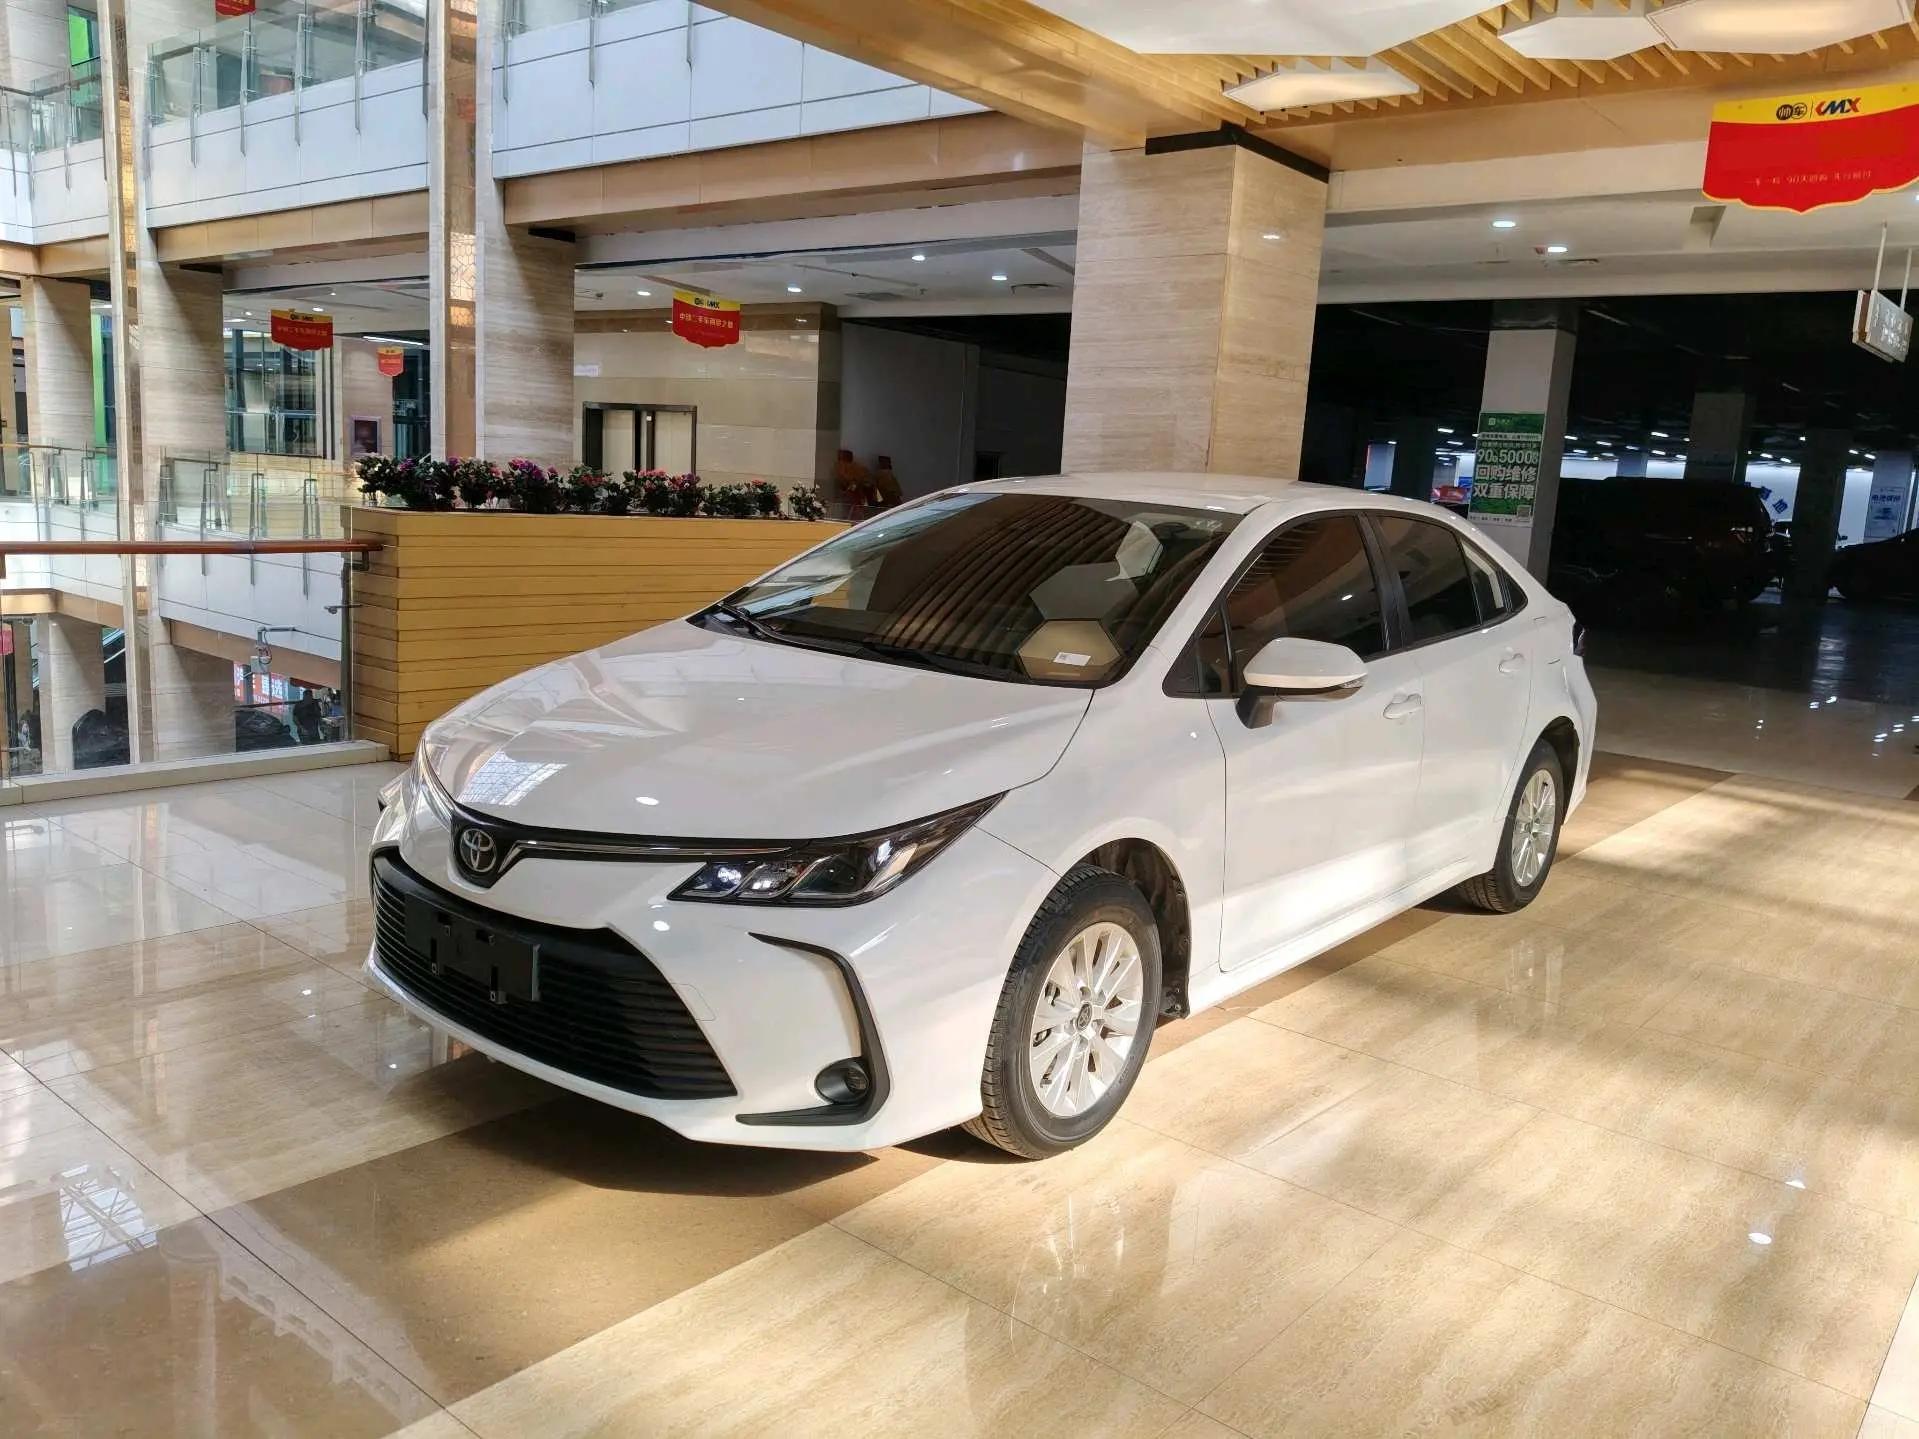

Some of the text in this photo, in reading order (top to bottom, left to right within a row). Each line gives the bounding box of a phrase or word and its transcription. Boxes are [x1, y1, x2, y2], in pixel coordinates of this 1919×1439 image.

[1475, 464, 1537, 482] 回购维修
[1472, 482, 1535, 500] 双重保障
